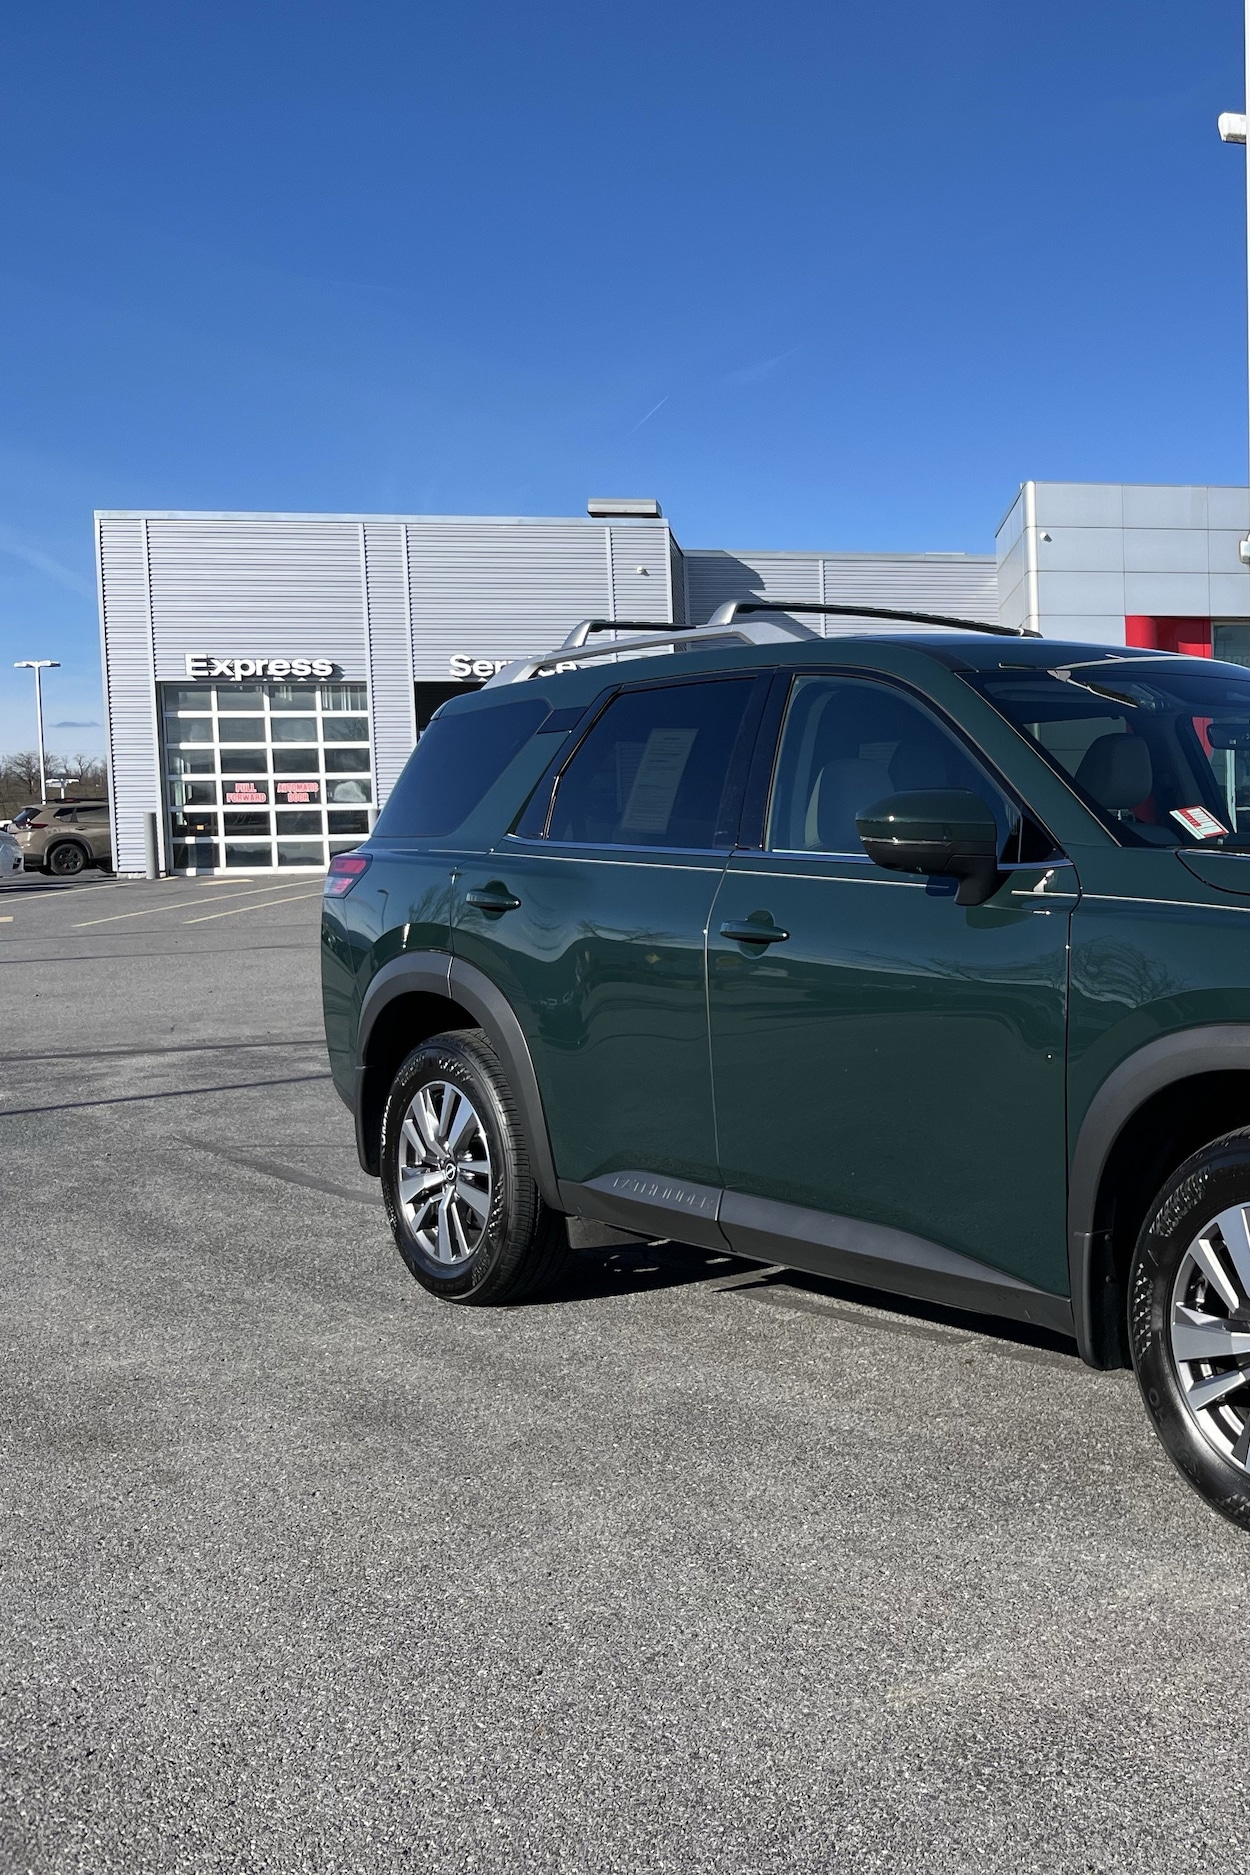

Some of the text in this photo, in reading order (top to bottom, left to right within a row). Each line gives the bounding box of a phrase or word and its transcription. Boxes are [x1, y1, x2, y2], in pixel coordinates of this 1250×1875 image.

[184, 653, 334, 682] Express
[449, 654, 577, 678] Sere
[235, 783, 257, 793] PULL
[277, 782, 319, 793] AUTOMATIC
[226, 792, 267, 803] FORWARD
[287, 792, 310, 803] DOOR
